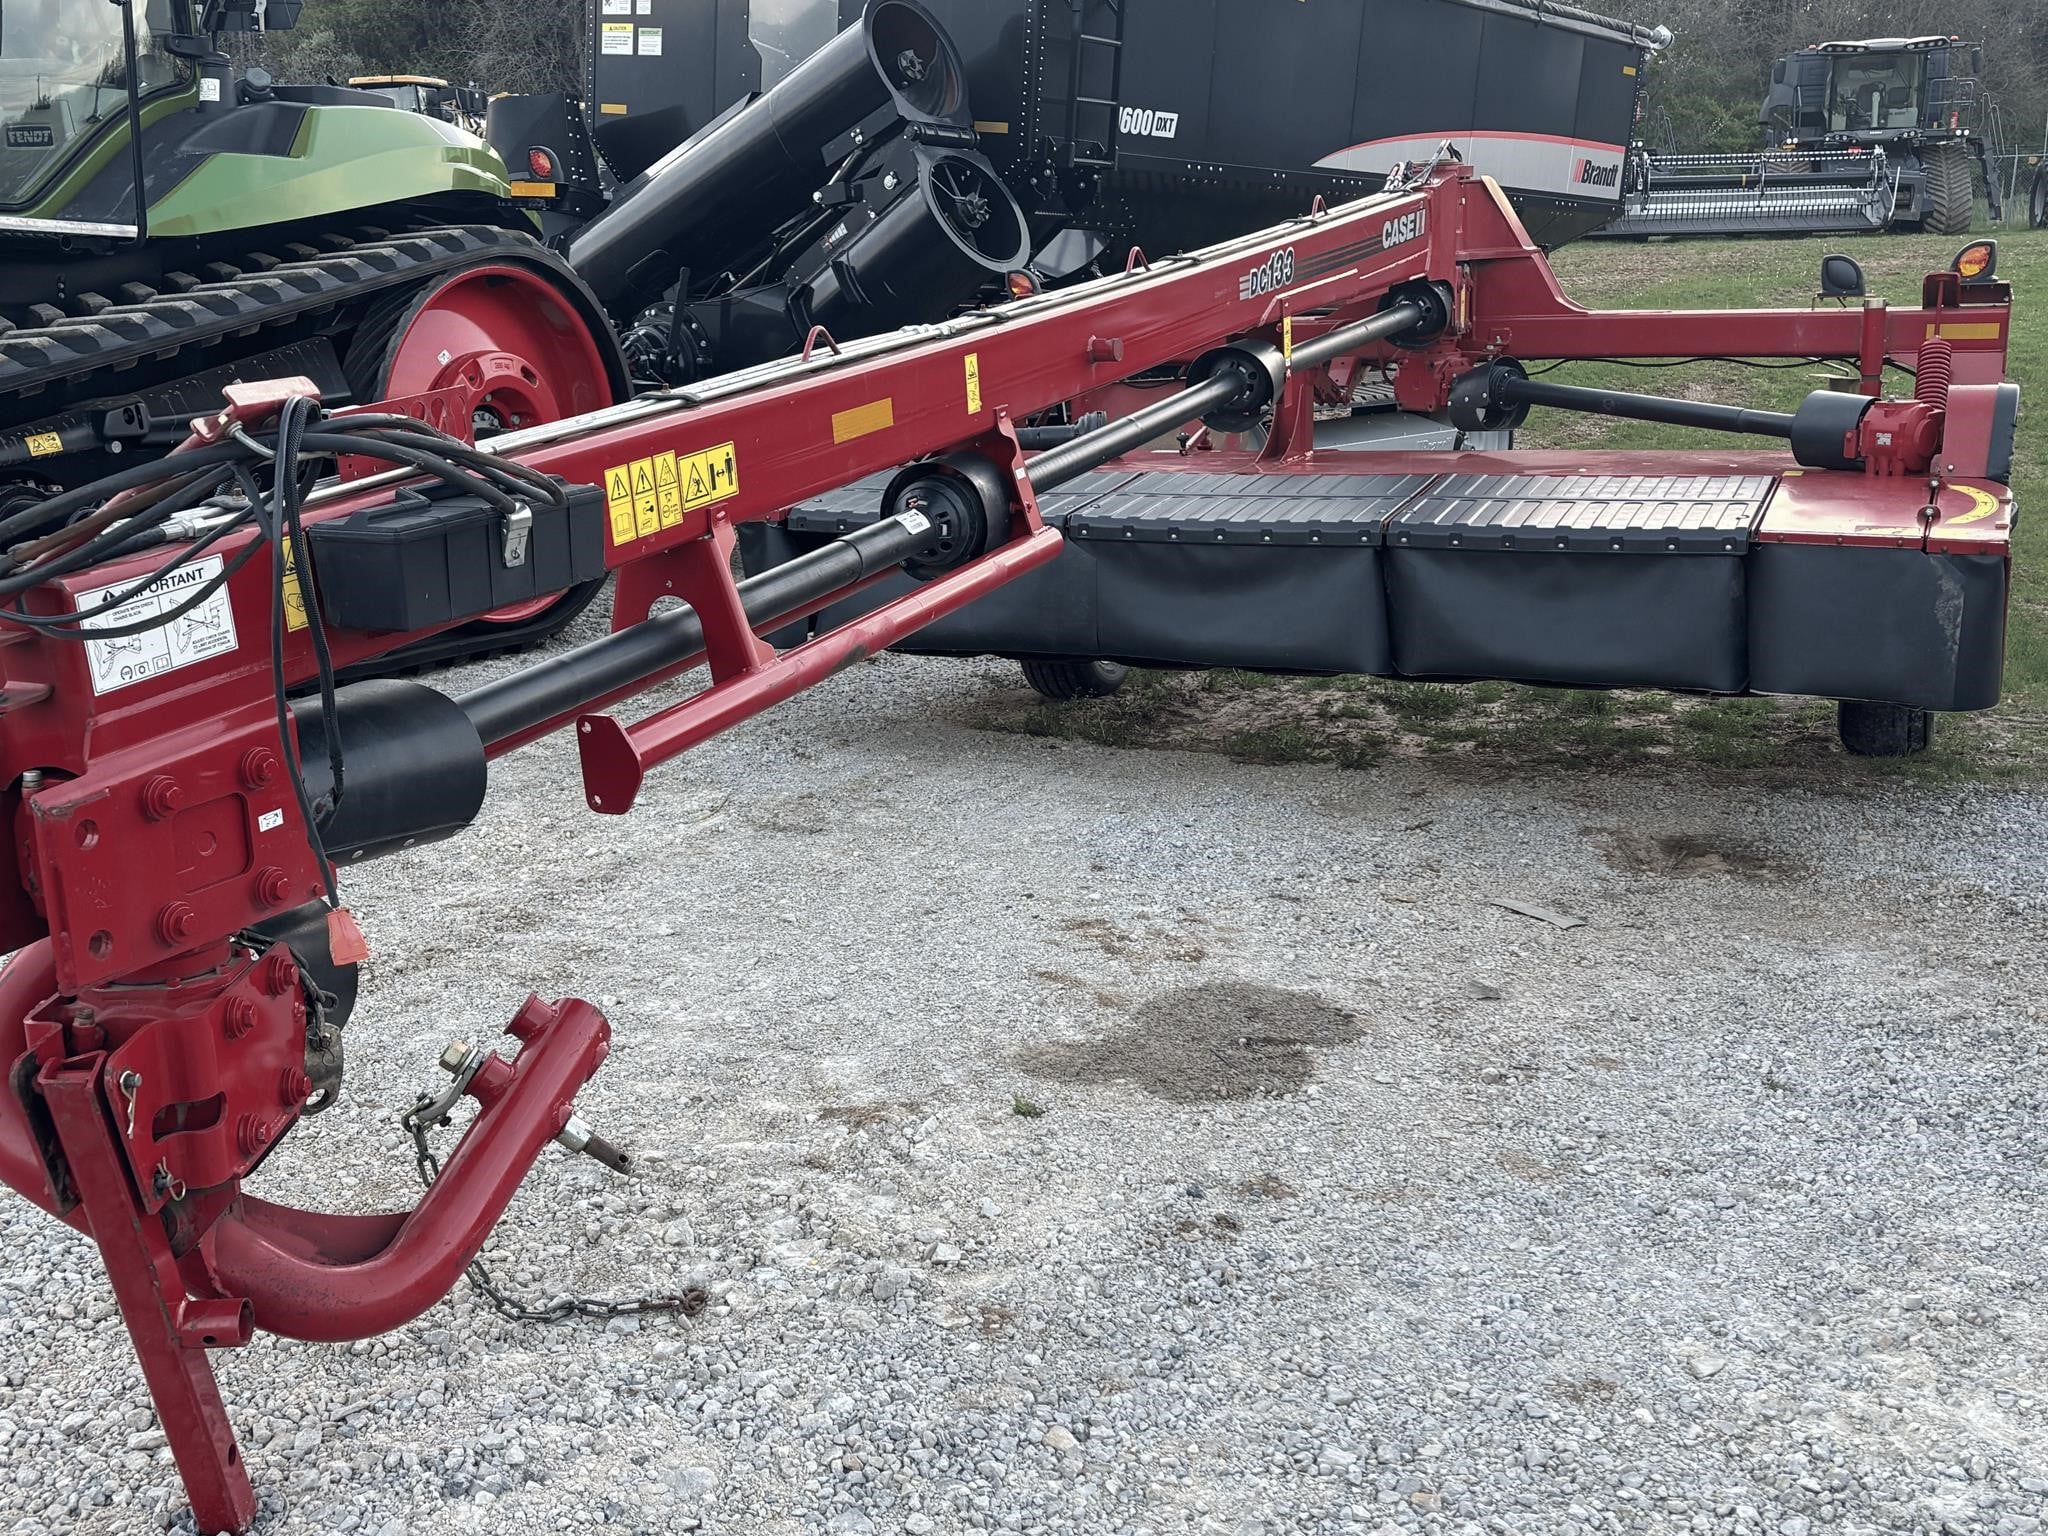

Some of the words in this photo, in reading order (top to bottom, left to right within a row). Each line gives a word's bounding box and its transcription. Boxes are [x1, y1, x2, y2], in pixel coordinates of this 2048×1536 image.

[7, 130, 51, 143] FENDT
[1155, 116, 1175, 133] DXT
[1581, 160, 1619, 187] Brandt
[1382, 213, 1416, 249] CASE
[1249, 246, 1295, 299] DC133
